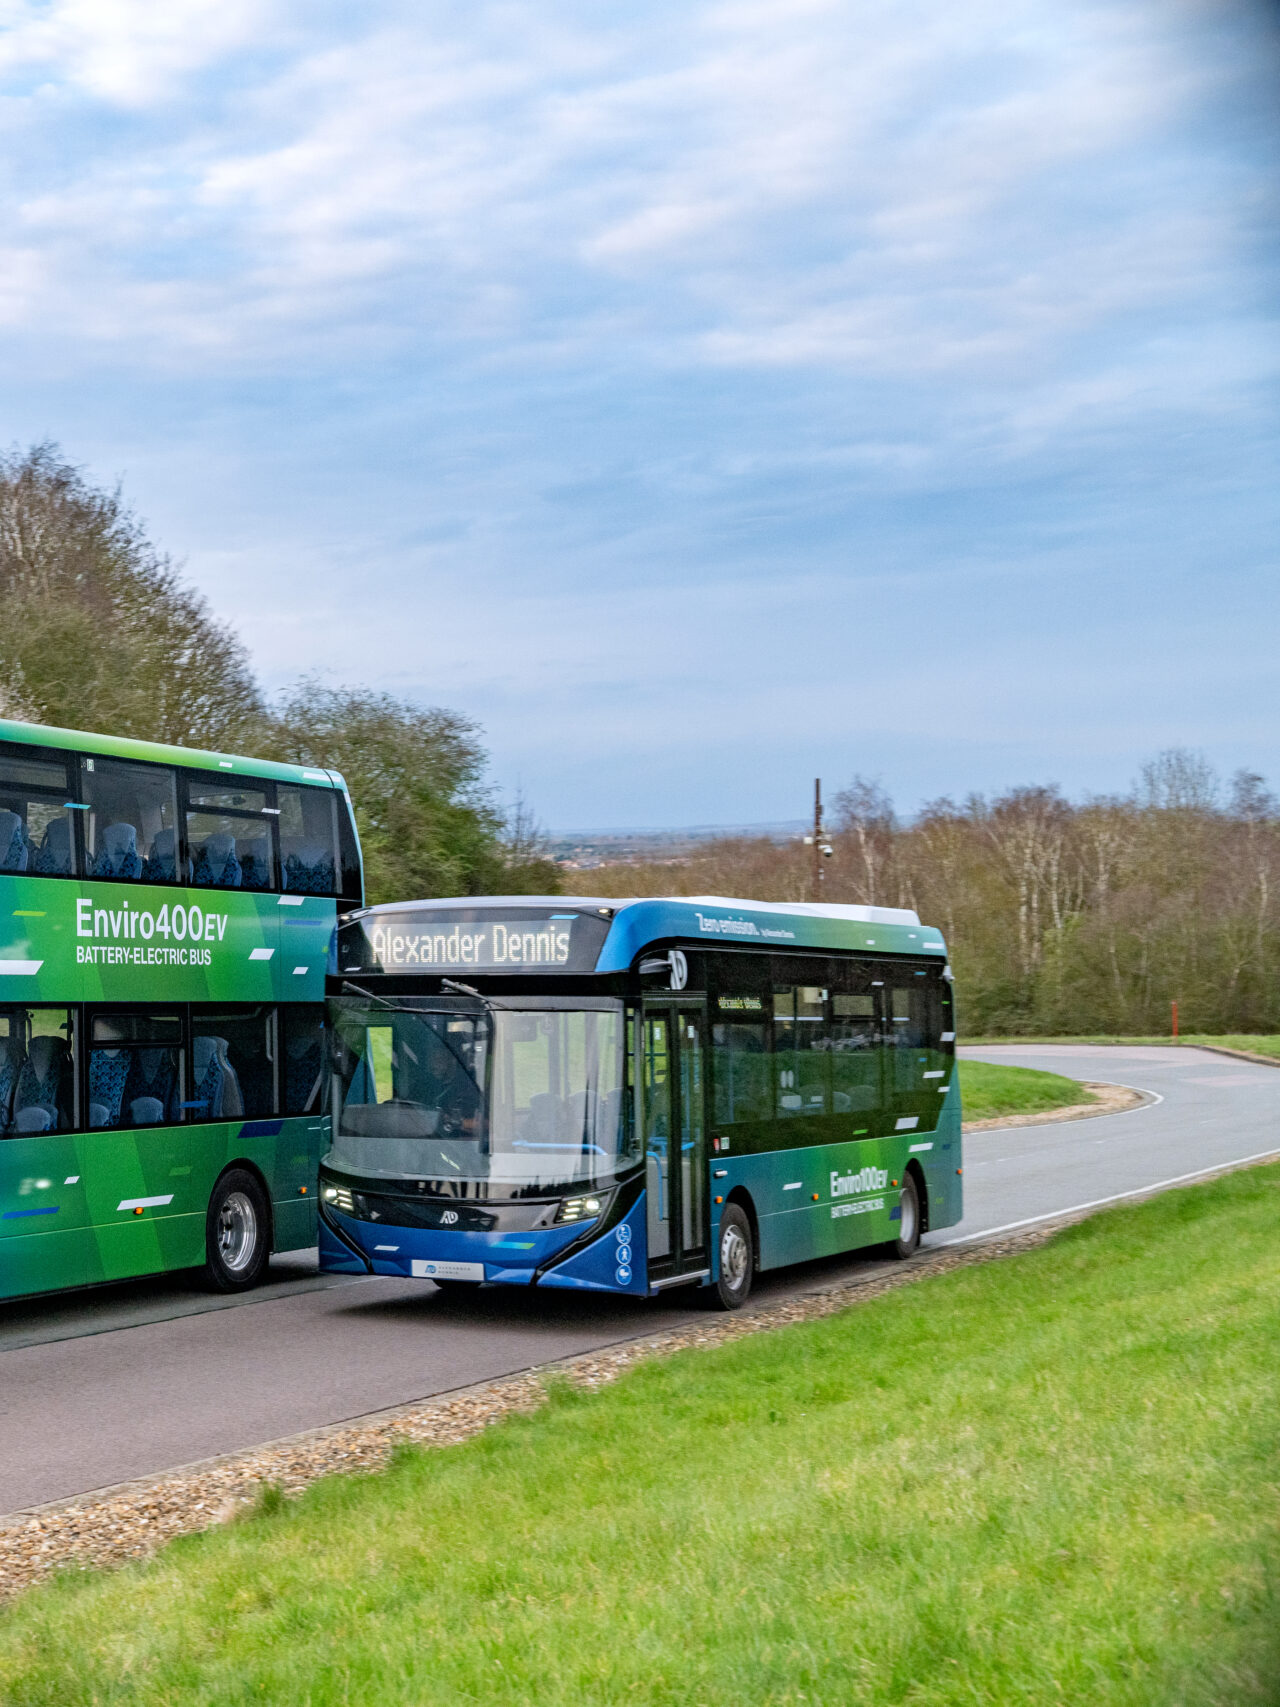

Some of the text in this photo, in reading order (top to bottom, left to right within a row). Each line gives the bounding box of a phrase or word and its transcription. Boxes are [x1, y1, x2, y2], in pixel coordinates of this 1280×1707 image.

[76, 898, 228, 941] Enviro400EV
[76, 946, 212, 966] BATTERY-ELECTRIC BUS
[372, 925, 570, 964] Alexander Dennis
